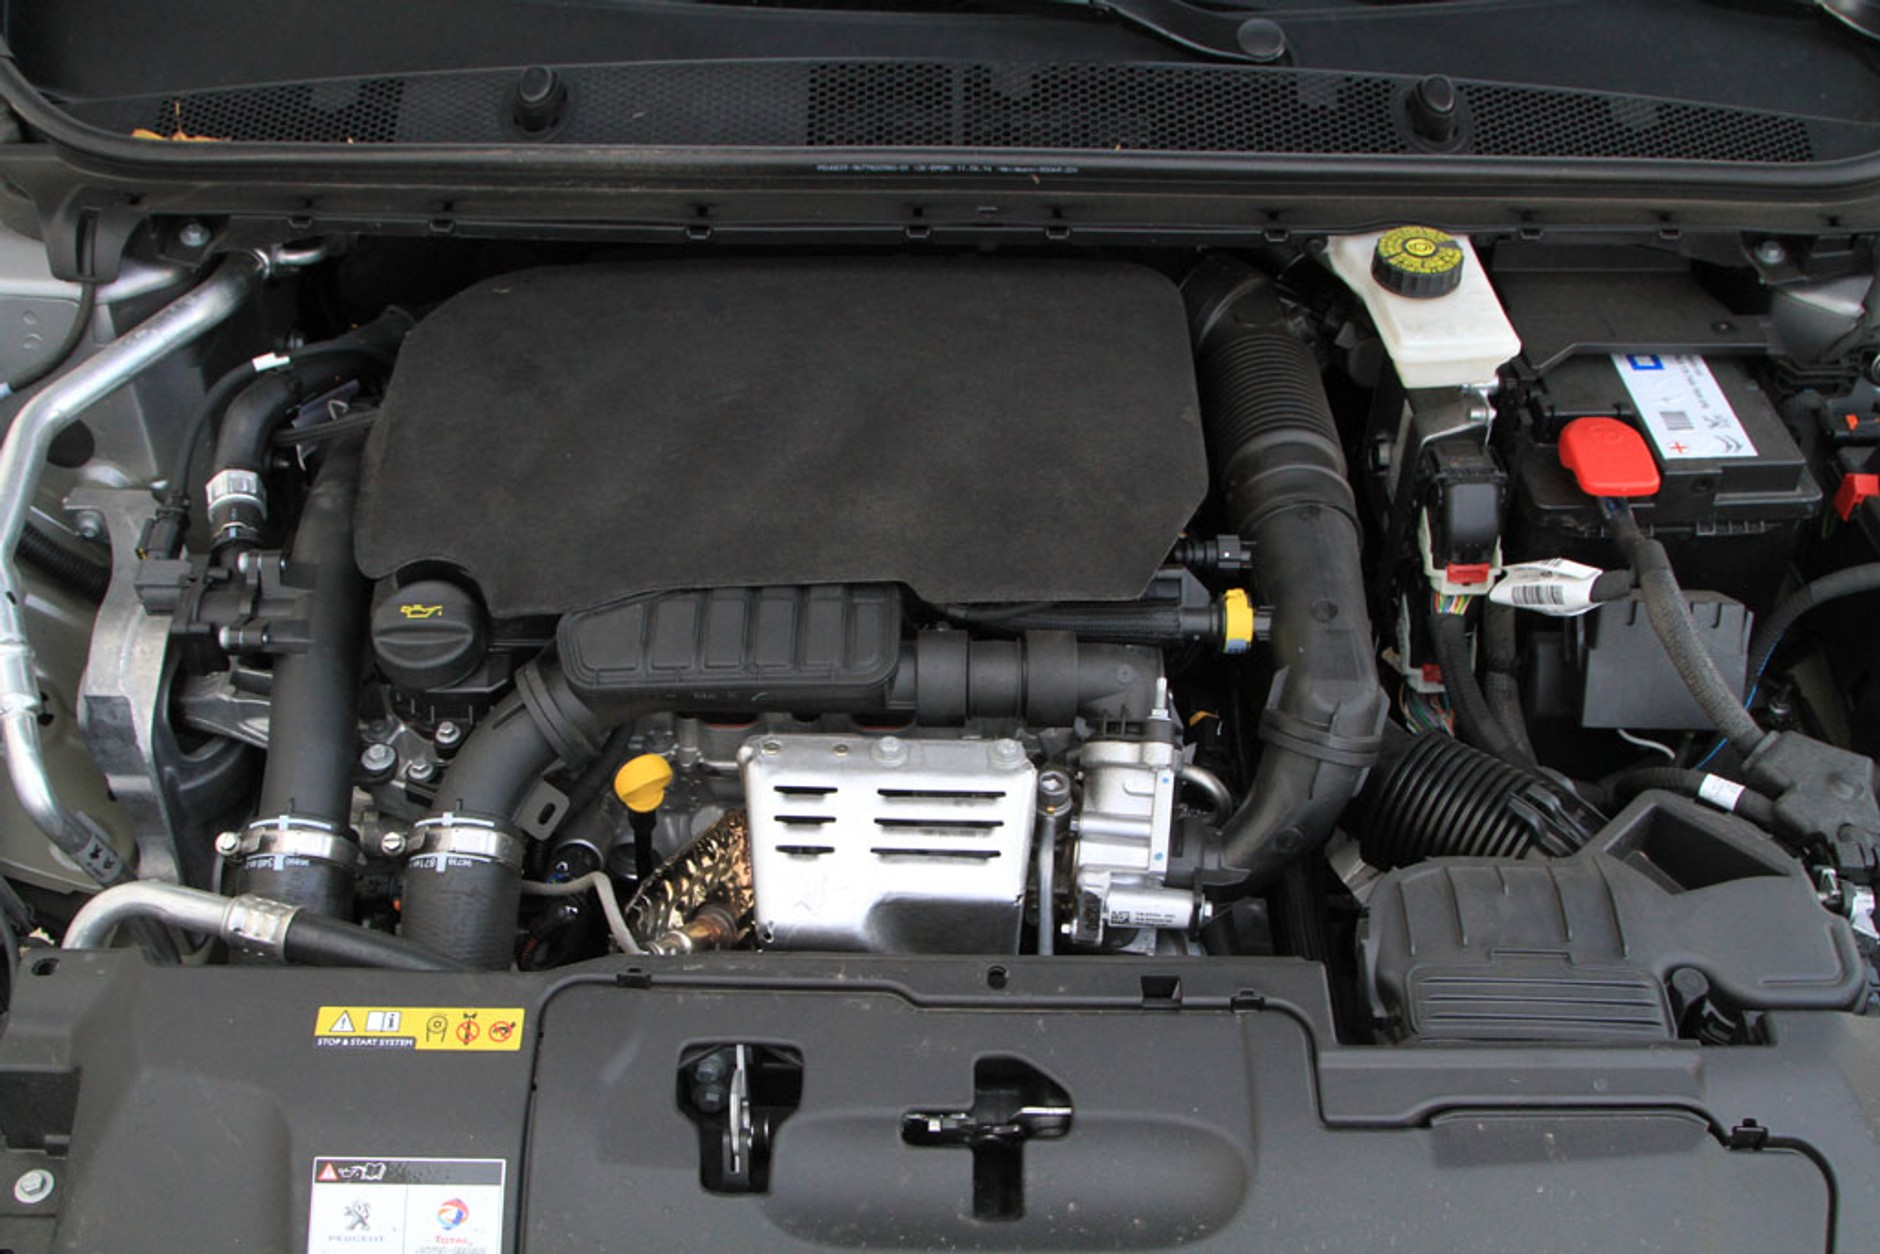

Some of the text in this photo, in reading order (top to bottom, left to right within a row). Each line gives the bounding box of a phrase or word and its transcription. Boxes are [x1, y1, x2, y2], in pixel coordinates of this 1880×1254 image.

[317, 1037, 342, 1047] STOP
[349, 1038, 377, 1047] START
[379, 1038, 413, 1047] SYSTEM
[328, 1234, 384, 1242] PEUGEOT
